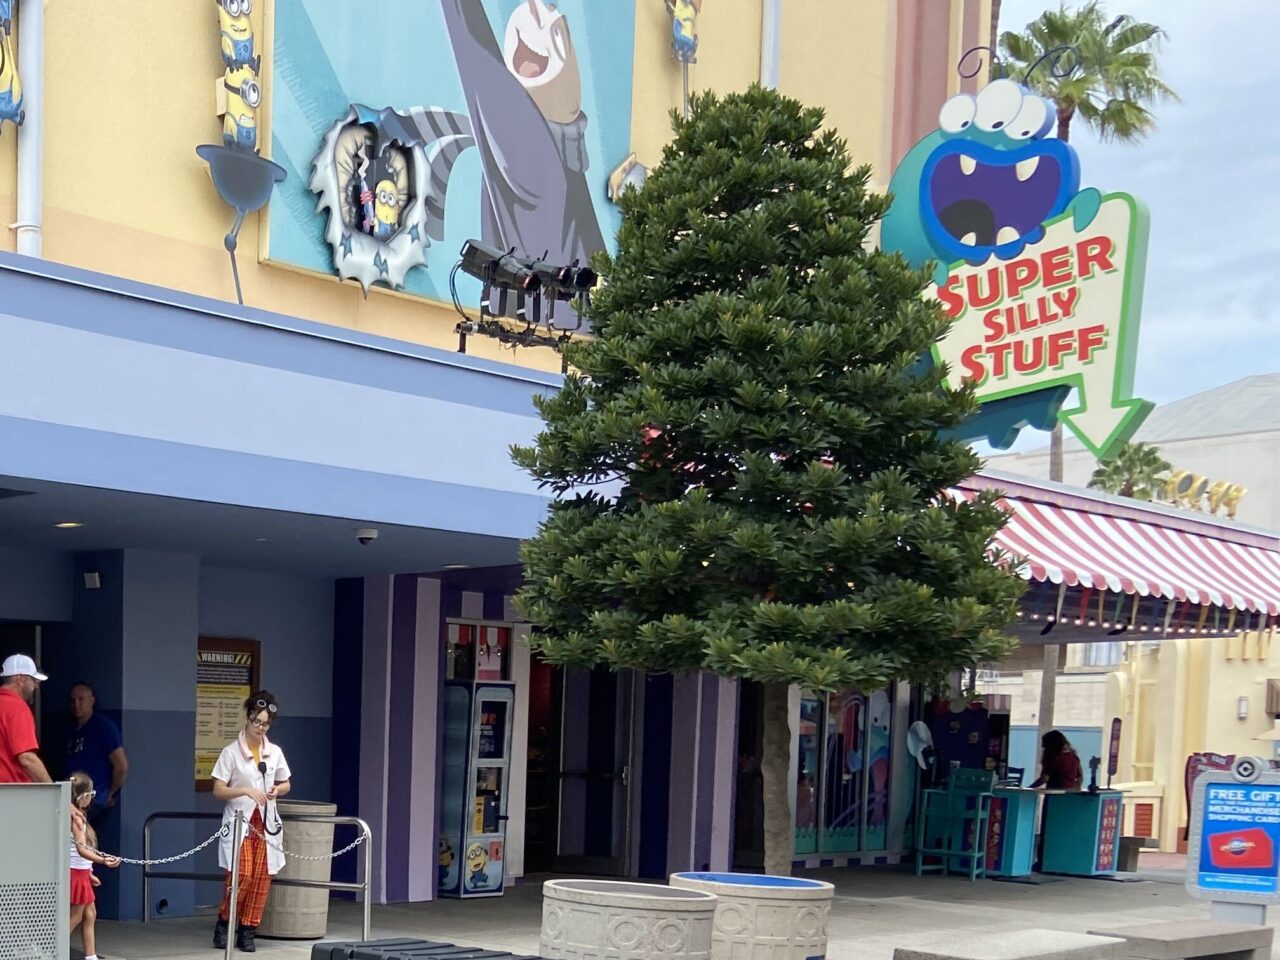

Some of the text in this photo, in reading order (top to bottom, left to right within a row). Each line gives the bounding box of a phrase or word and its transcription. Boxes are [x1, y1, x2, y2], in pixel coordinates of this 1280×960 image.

[937, 236, 1114, 318] SUPER
[983, 287, 1078, 343] SILLY
[961, 324, 1106, 384] STUFF
[201, 652, 235, 664] WARNING!
[1210, 789, 1280, 802] FREE GIFT
[1208, 813, 1254, 822] SHOPPING
